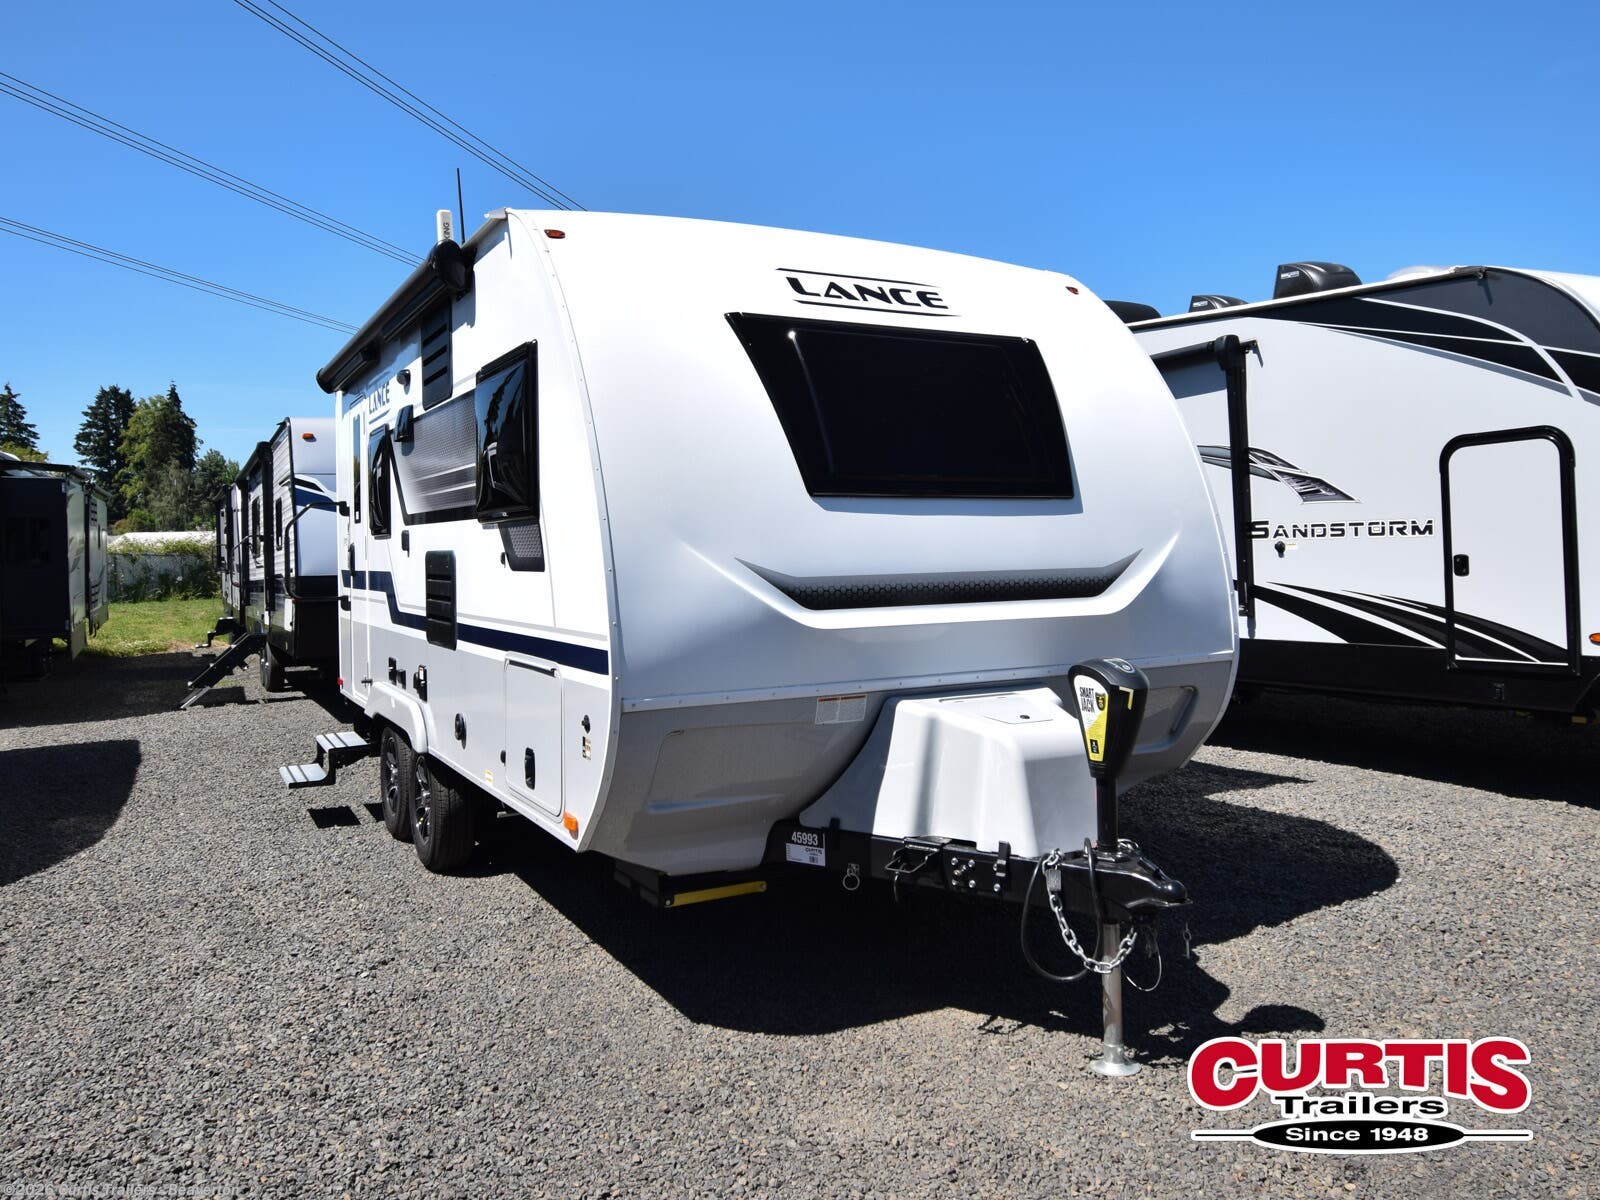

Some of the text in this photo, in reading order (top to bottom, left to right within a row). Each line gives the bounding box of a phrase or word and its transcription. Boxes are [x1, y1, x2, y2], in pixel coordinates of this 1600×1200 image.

[785, 276, 949, 310] LANCE
[368, 380, 390, 415] LANCE
[1248, 519, 1434, 540] SANDSTORM
[1079, 686, 1095, 699] SMART
[1081, 698, 1096, 713] JACK
[791, 831, 818, 846] 45993
